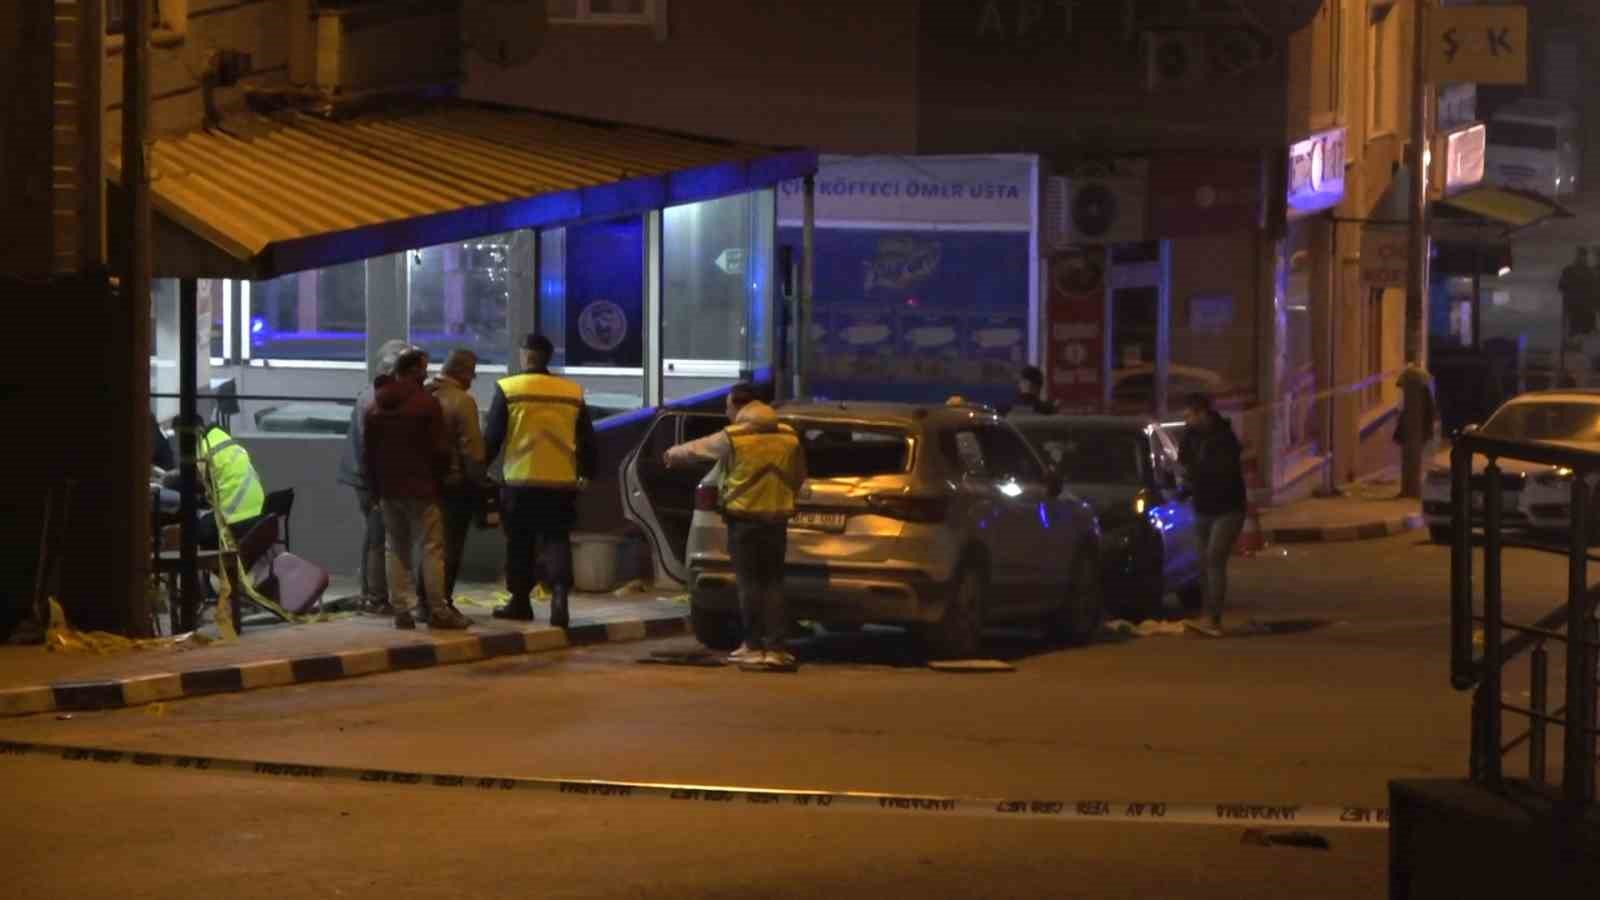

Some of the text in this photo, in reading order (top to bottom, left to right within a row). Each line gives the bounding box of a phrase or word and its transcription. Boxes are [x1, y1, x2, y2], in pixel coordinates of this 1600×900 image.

[1441, 26, 1513, 64] ŞK
[969, 183, 1020, 199] USTA
[1126, 801, 1167, 817] OLAY
[1216, 803, 1298, 820] JANDARMA
